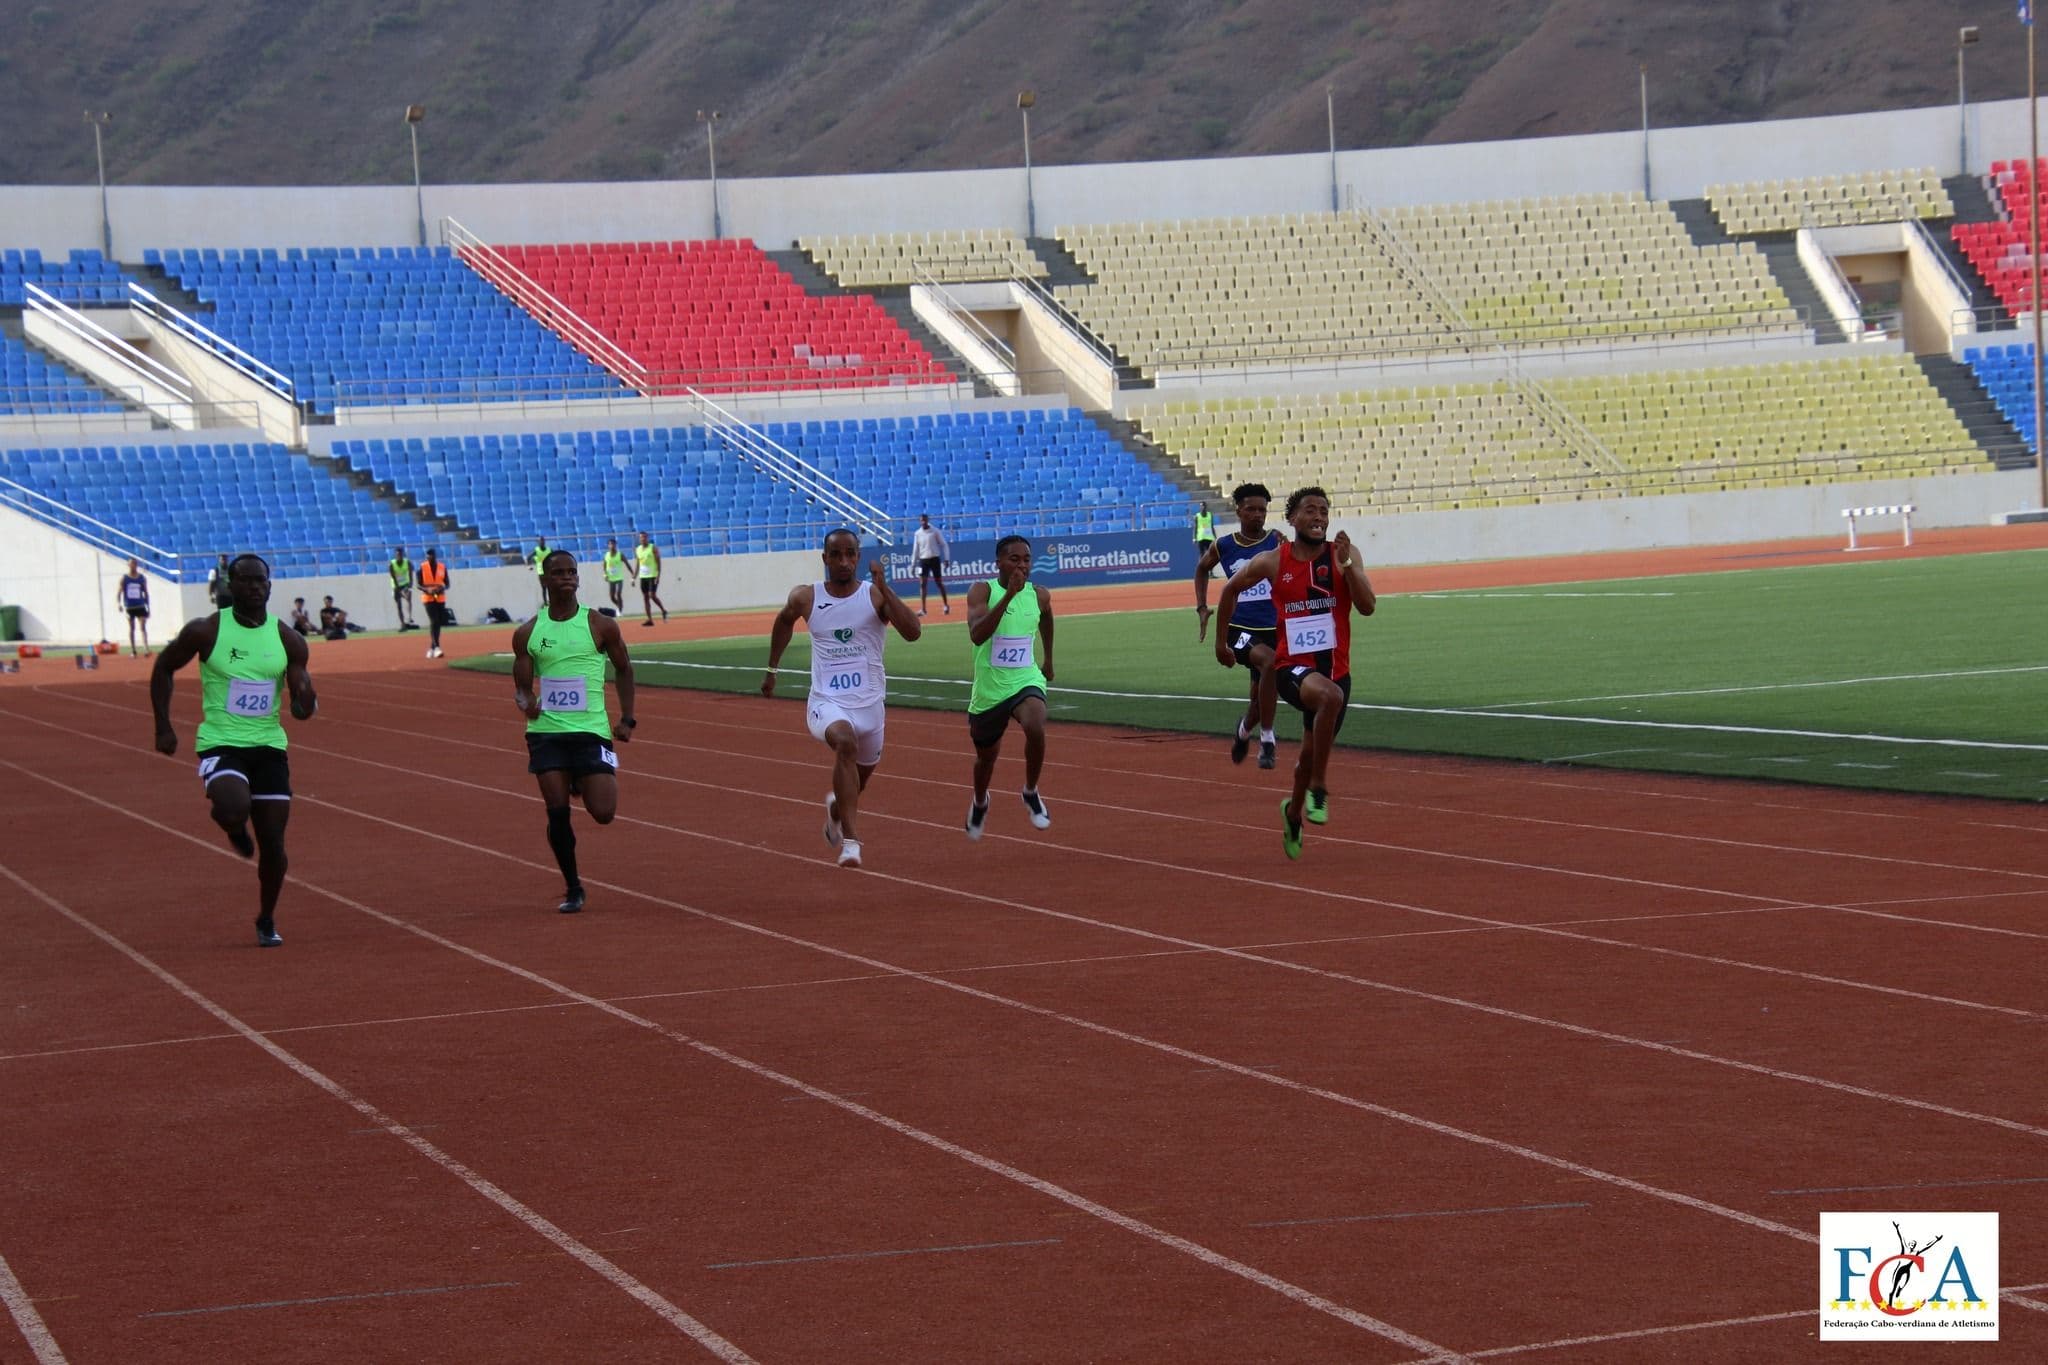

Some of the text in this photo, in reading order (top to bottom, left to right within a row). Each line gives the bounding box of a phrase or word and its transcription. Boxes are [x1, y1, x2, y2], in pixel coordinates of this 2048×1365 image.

[1057, 543, 1090, 554] Banco
[1058, 548, 1170, 570] Interatlântico
[1295, 630, 1327, 647] 452
[998, 648, 1026, 662] 427
[829, 673, 861, 690] 400
[236, 695, 268, 710] 428
[548, 691, 580, 706] 429
[203, 758, 215, 773] 7
